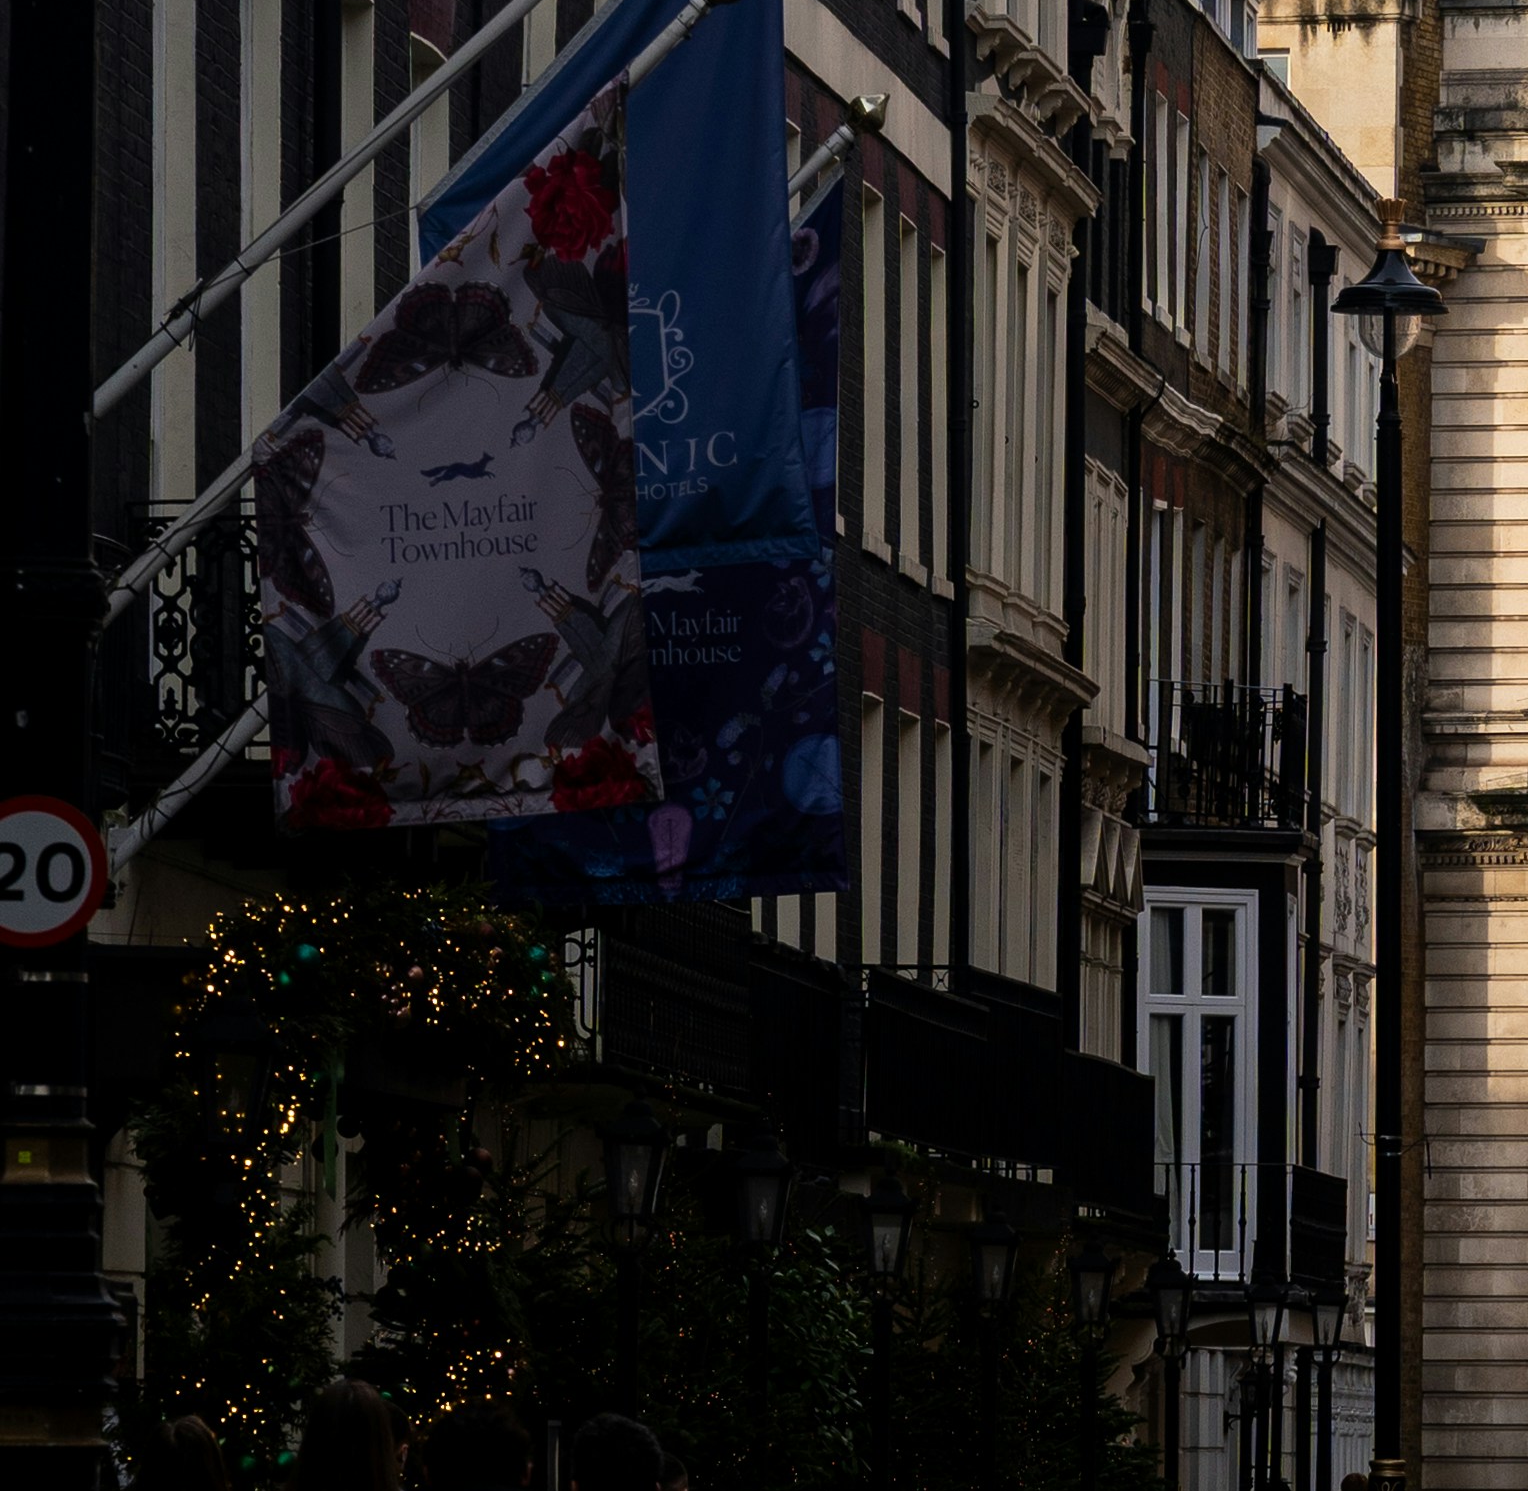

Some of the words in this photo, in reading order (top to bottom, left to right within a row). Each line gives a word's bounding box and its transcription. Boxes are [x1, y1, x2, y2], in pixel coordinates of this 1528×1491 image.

[635, 430, 738, 477] NIC
[635, 476, 709, 502] HOTELS
[379, 503, 437, 532] The
[443, 494, 538, 532] Mayfair
[381, 532, 538, 564] Townhouse
[650, 608, 742, 642] Mayfair
[649, 639, 742, 666] nhouse
[0, 842, 85, 902] 20
